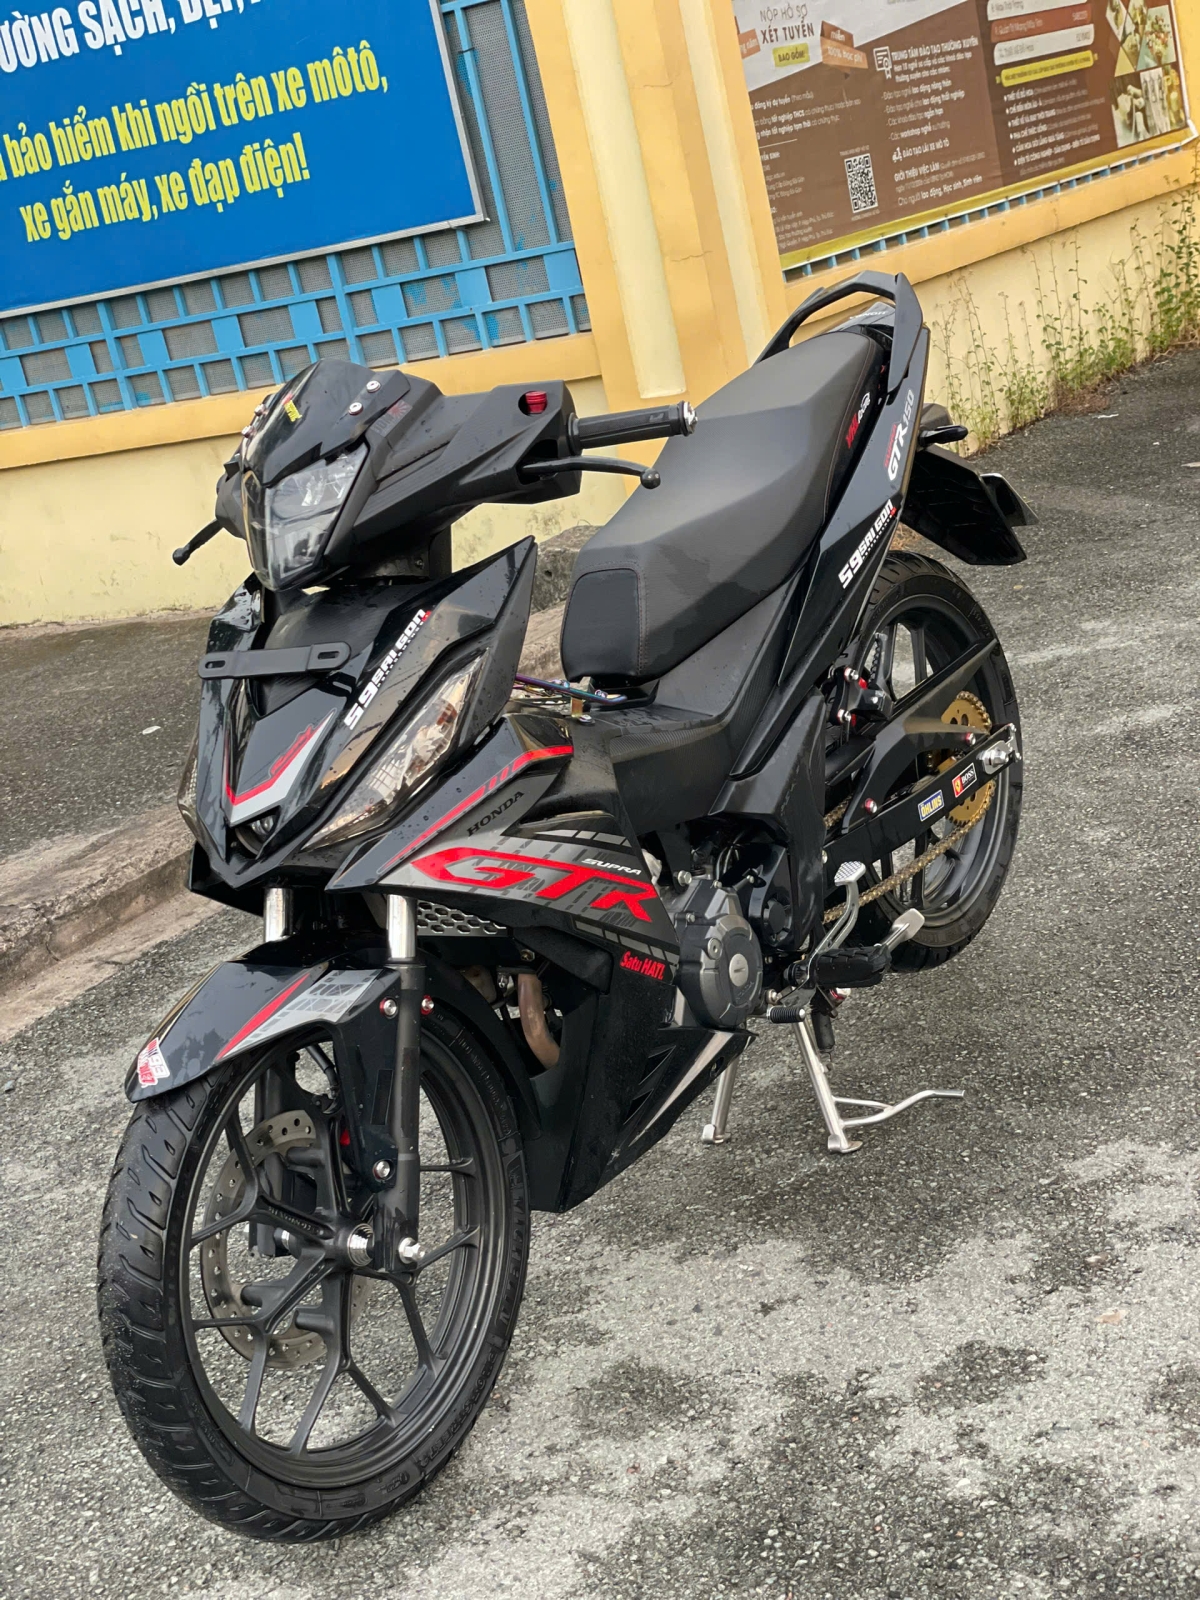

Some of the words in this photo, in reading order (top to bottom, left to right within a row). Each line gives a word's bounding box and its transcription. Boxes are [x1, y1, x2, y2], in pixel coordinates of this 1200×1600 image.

[760, 7, 778, 22] NỘP
[782, 3, 794, 19] HỒ
[78, 0, 176, 56] SẠCH,
[761, 25, 781, 44] XÉT
[782, 18, 814, 41] TUYỂN
[778, 52, 790, 62] BAO
[892, 50, 908, 60] TRUNG
[908, 46, 919, 58] TÂM
[919, 44, 930, 56] ĐÀO
[930, 44, 940, 55] TẠO
[941, 40, 962, 52] THƯỜNG
[920, 84, 930, 93] động
[930, 95, 941, 105] động
[3, 122, 52, 178] bảo
[49, 105, 116, 166] hiểm
[112, 98, 157, 152] khi
[154, 82, 216, 144] ngồi
[214, 72, 274, 126] trên
[270, 66, 306, 112] xe
[306, 40, 388, 102] môtô,
[912, 146, 922, 156] TẠO
[919, 164, 929, 176] VIỆC
[930, 161, 940, 172] LÀM
[19, 202, 52, 242] xe
[50, 180, 100, 240] gắn
[96, 172, 159, 222] máy,
[154, 170, 188, 213] xe
[188, 158, 240, 213] đạp
[239, 132, 310, 198] điện!
[838, 546, 864, 589] 59
[344, 681, 378, 730] 59
[961, 768, 975, 784] BOSS
[466, 790, 524, 837] HONDA
[582, 858, 642, 876] SUPRA
[411, 846, 660, 922] GTR
[620, 950, 642, 973] Satu
[499, 1195, 524, 1326] MICHELIN
